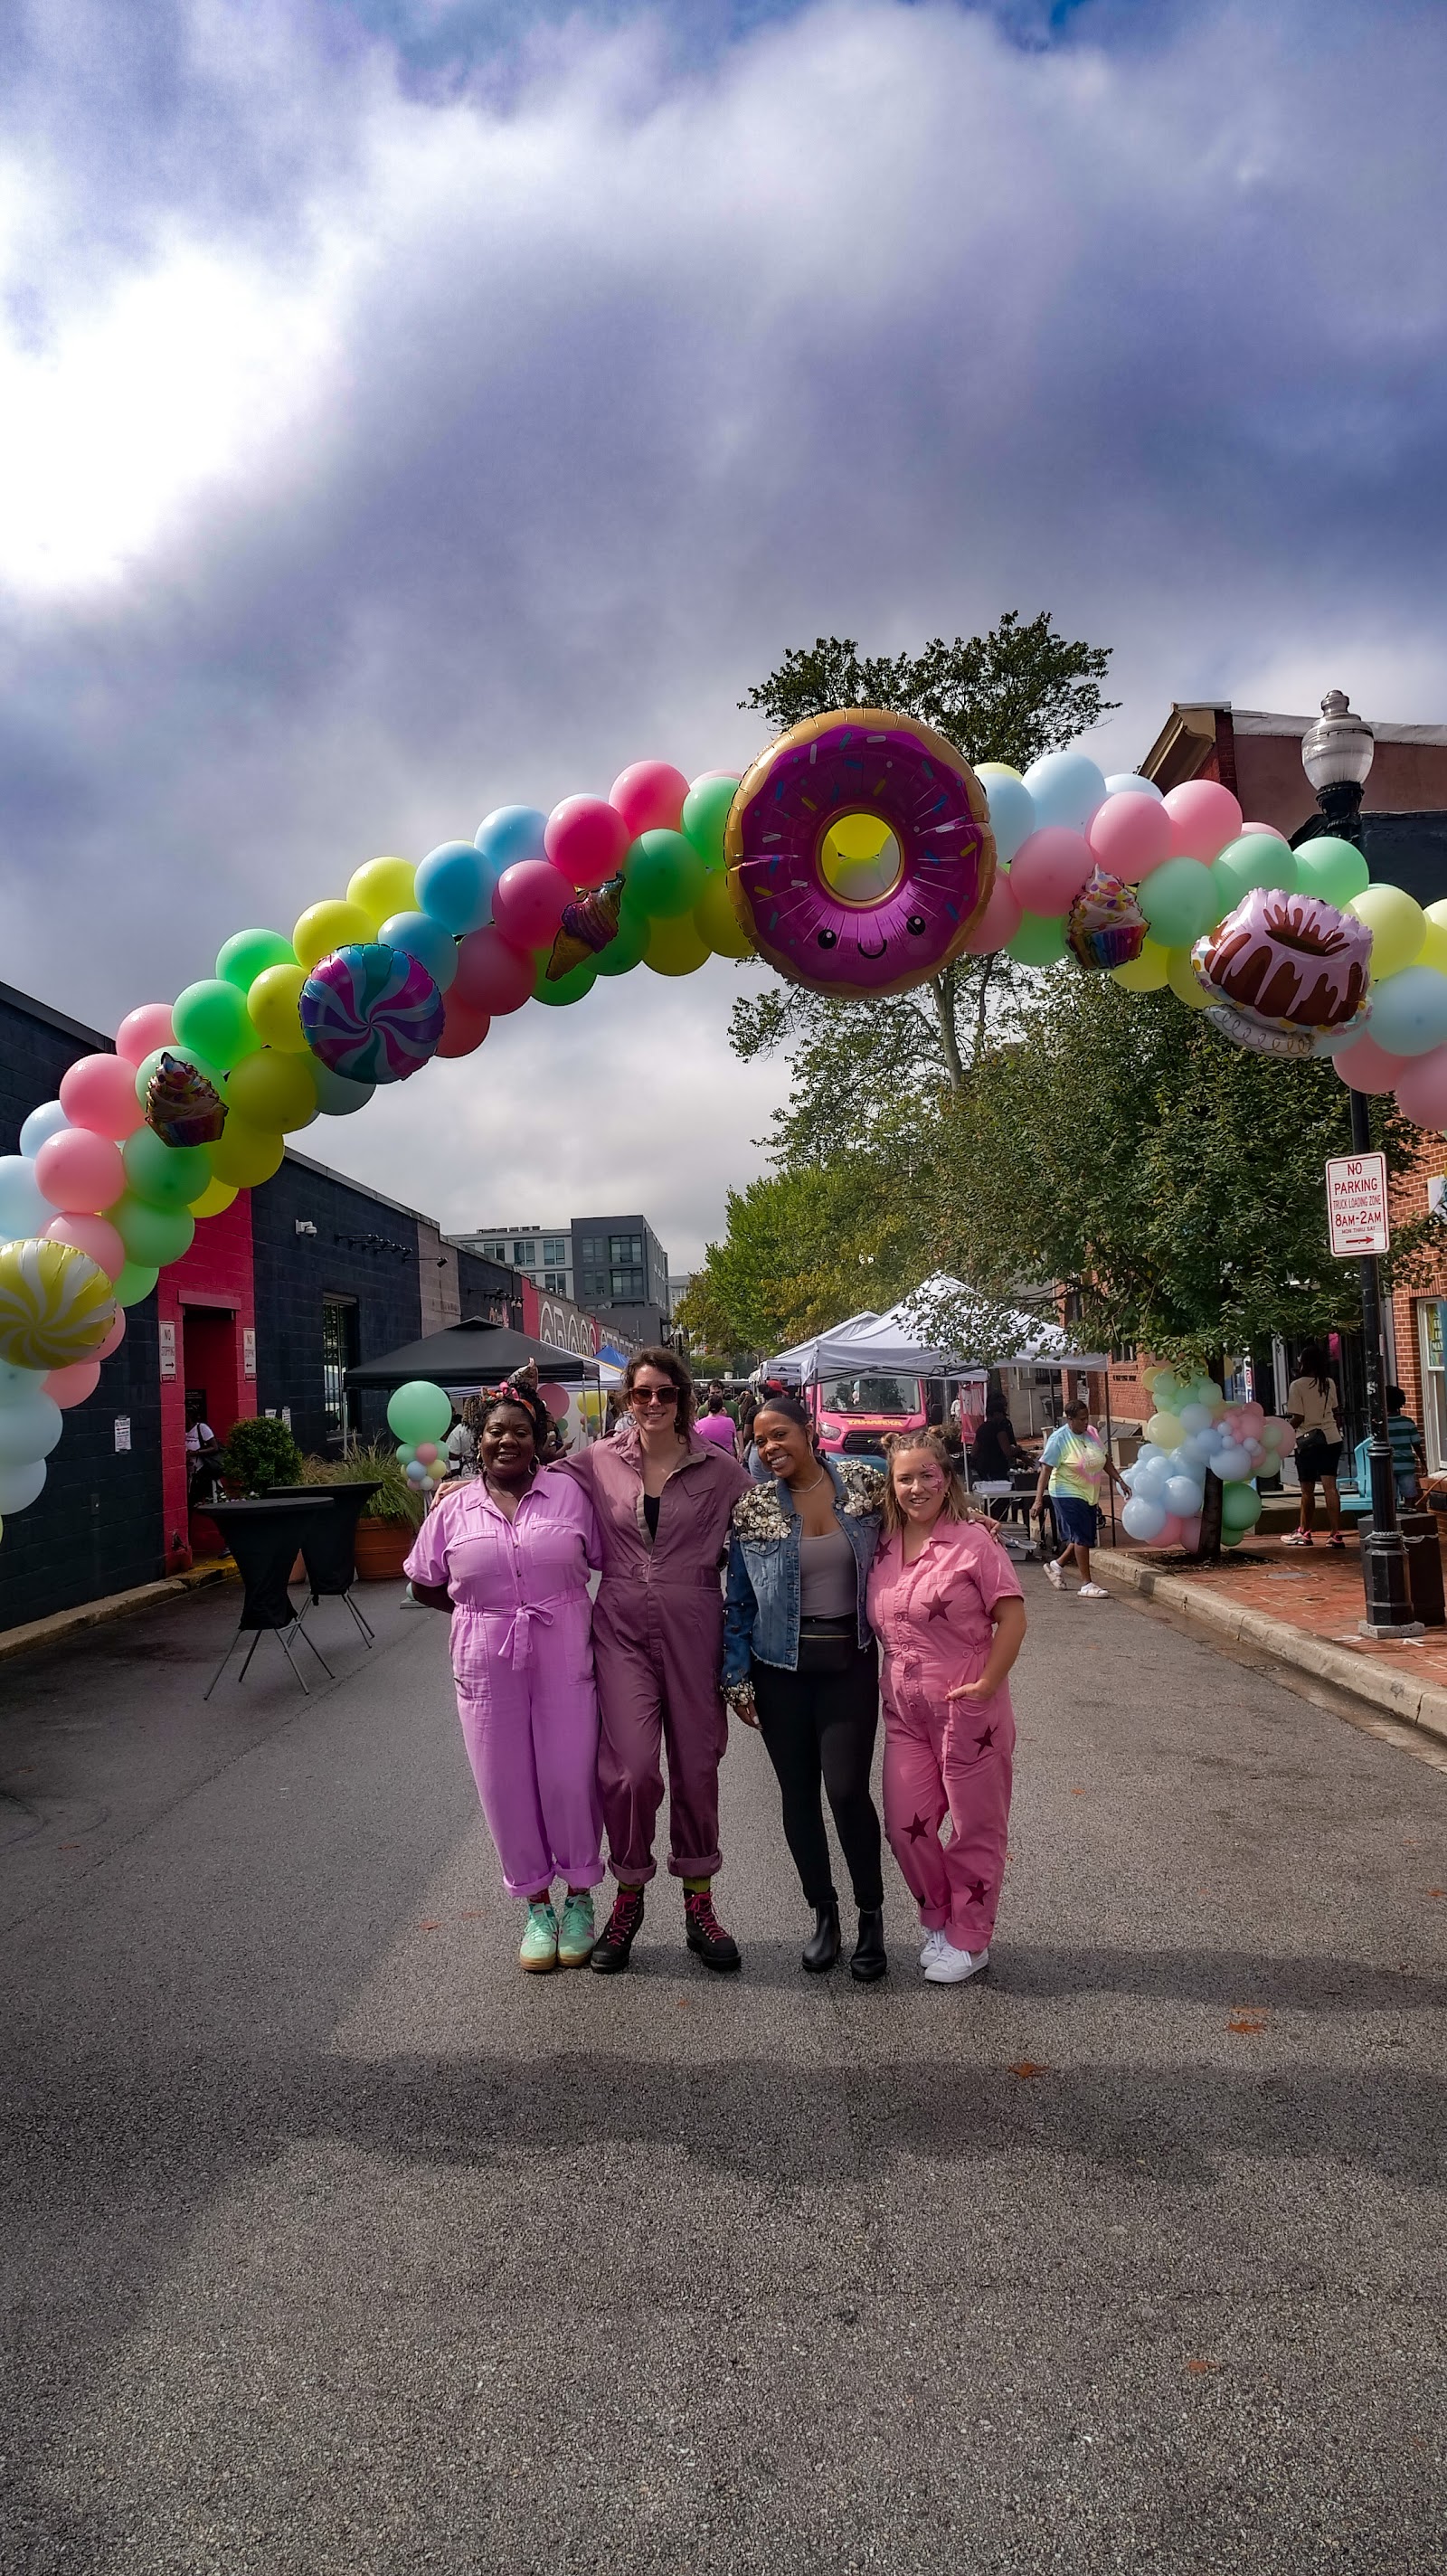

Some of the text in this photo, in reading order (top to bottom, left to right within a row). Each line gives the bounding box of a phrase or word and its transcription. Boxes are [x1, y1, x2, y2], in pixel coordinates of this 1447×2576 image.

[1347, 1162, 1362, 1176] NO
[1334, 1178, 1377, 1195] PARKING
[1333, 1195, 1381, 1210] TRUCK LOADING ZONE
[1335, 1211, 1382, 1227] 8AM-2AM
